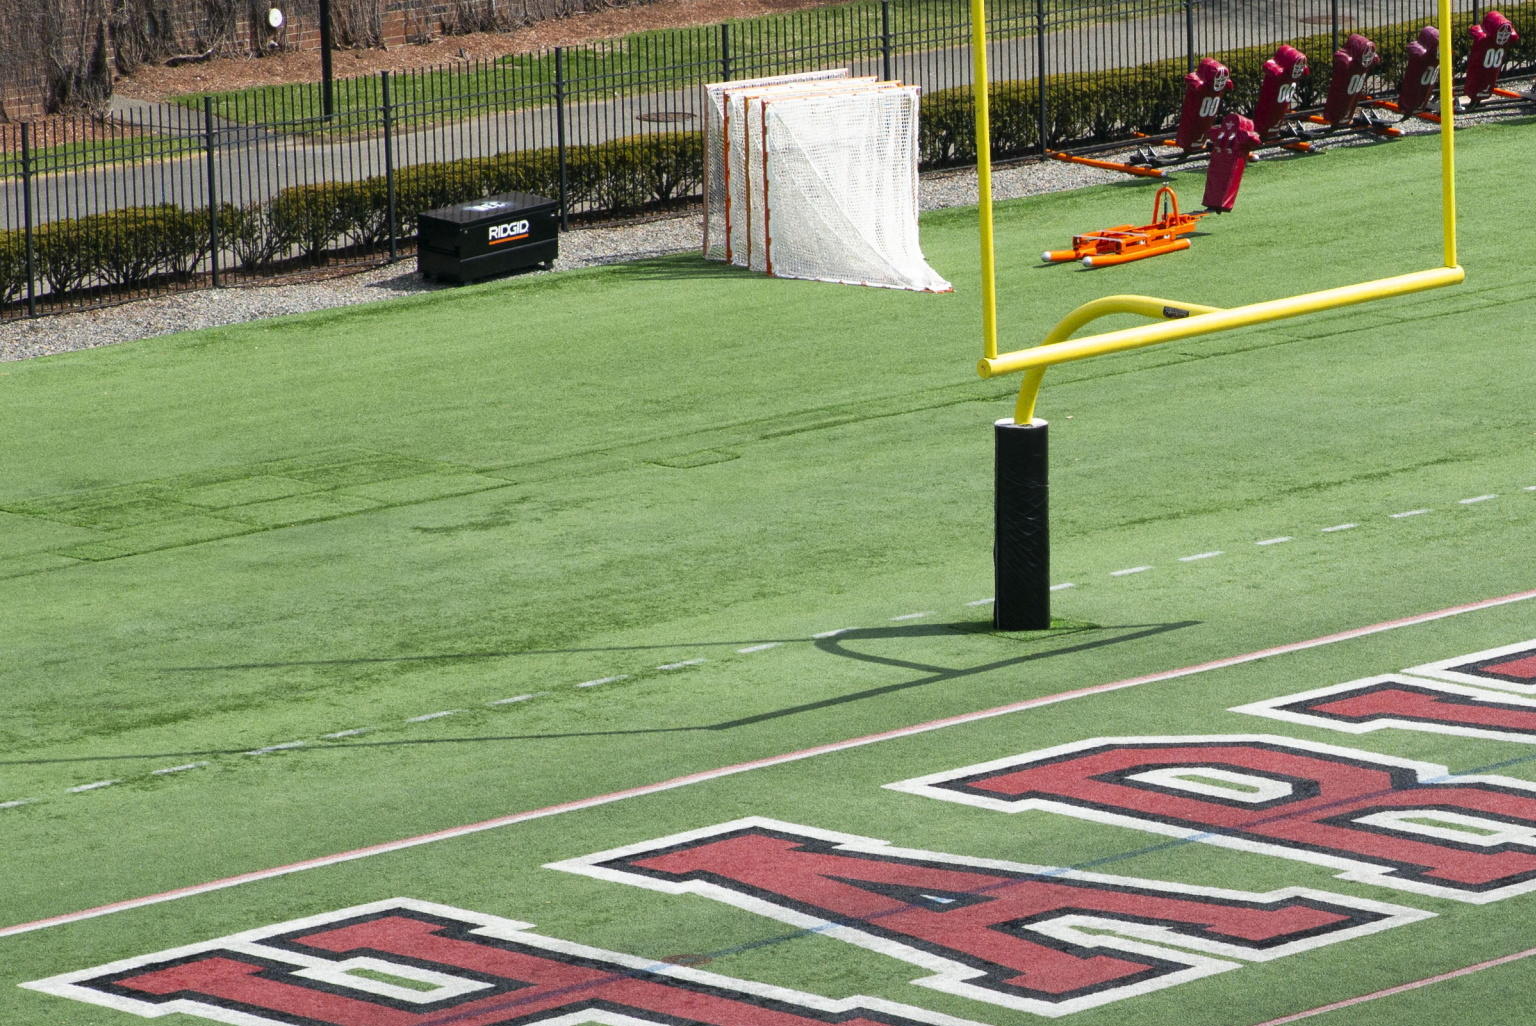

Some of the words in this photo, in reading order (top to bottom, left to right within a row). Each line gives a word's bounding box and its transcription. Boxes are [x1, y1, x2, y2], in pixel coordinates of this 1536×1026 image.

[1483, 48, 1504, 69] 00
[1278, 83, 1296, 104] 00
[1199, 96, 1220, 117] 00
[488, 220, 530, 240] RIDGID
